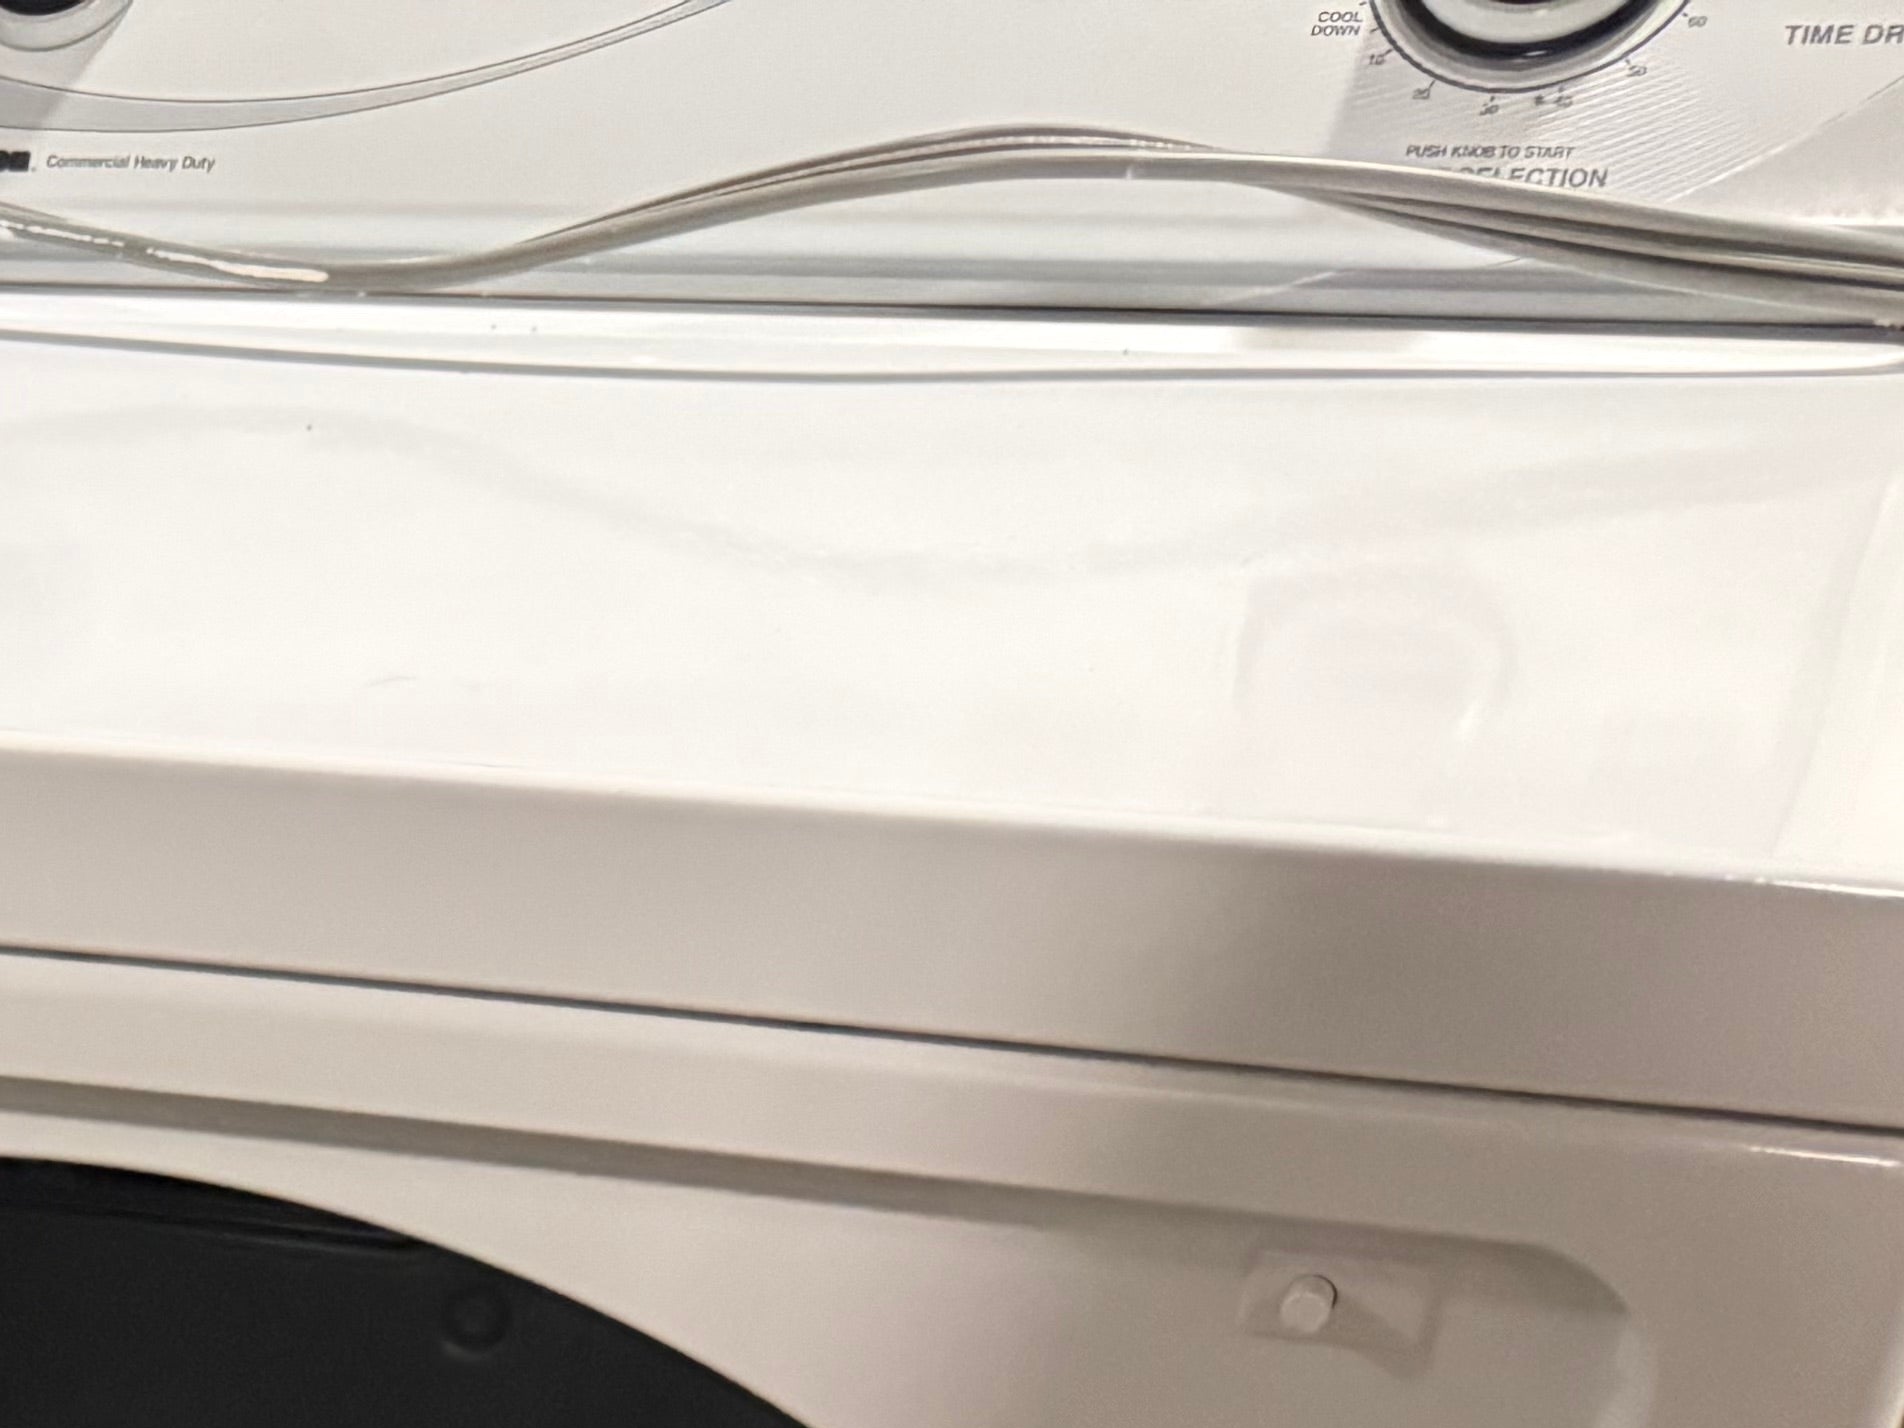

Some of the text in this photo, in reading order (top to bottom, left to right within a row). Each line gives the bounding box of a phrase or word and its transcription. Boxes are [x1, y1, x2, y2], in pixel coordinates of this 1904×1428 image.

[1318, 11, 1363, 23] COOL
[1311, 25, 1360, 36] DOWN
[1785, 24, 1855, 45] TIME
[1406, 144, 1575, 159] PUSH KNOB TO START
[134, 155, 178, 172] Heavy
[182, 156, 215, 172] Duty
